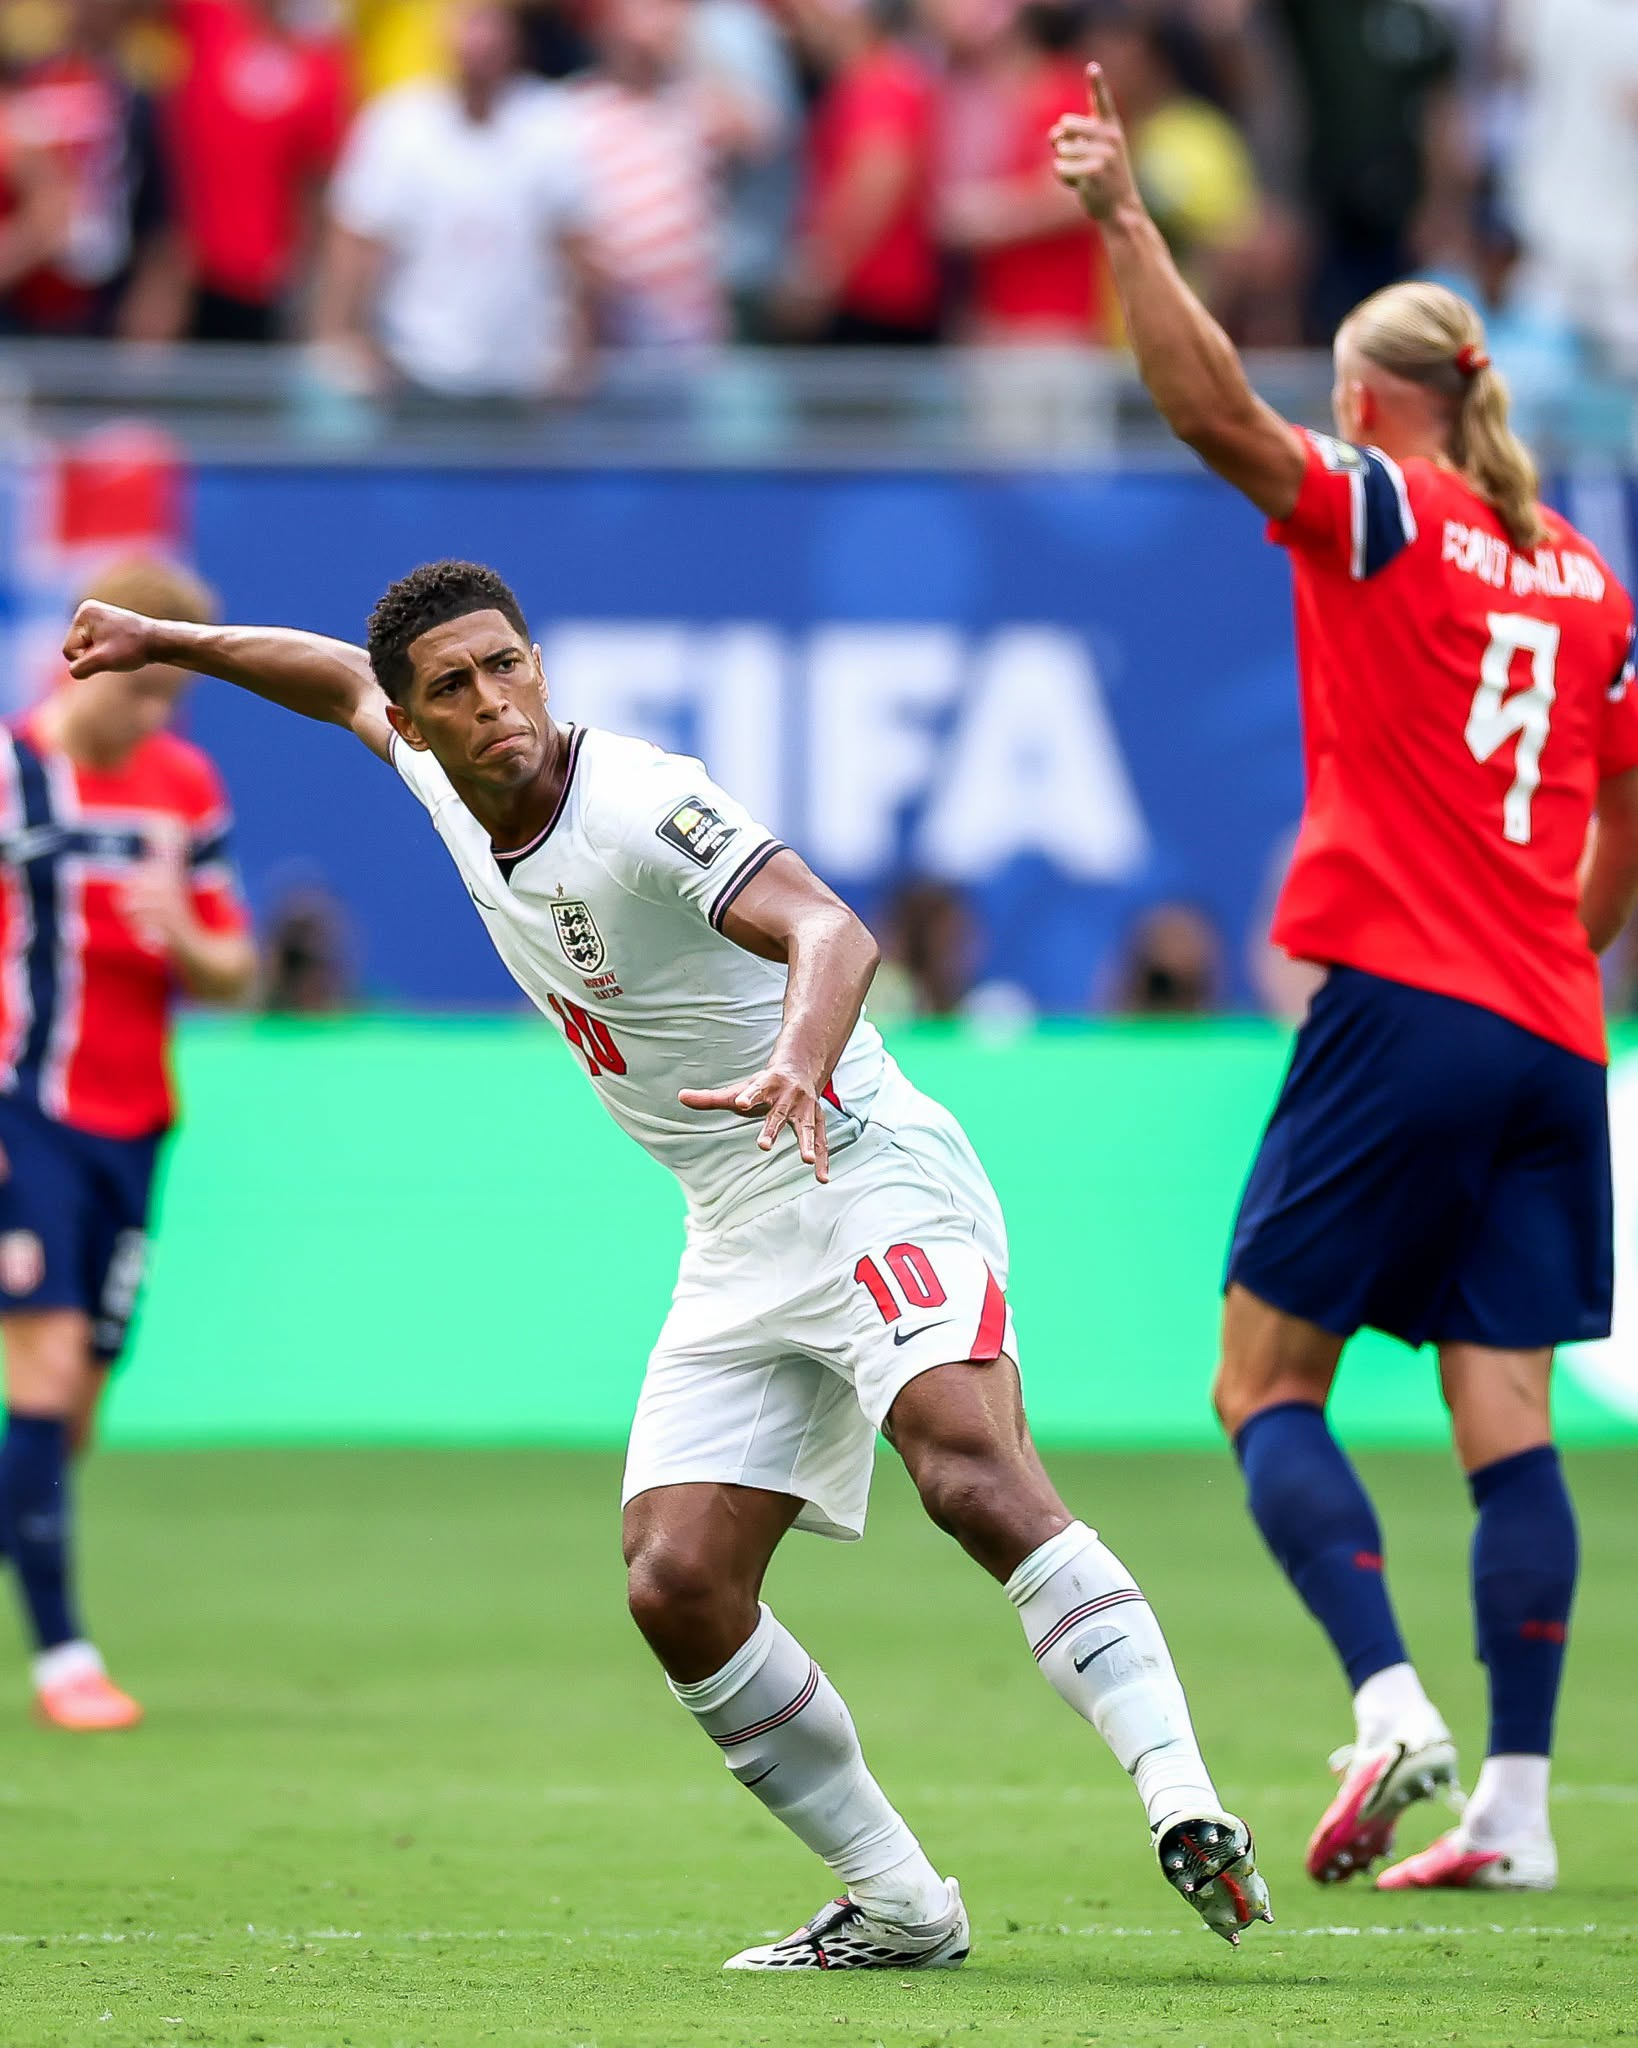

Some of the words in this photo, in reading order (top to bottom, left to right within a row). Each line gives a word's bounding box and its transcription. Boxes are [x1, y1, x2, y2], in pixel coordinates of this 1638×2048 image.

[1464, 611, 1561, 845] 9
[546, 992, 628, 1077] 10
[853, 1242, 948, 1325] 10
